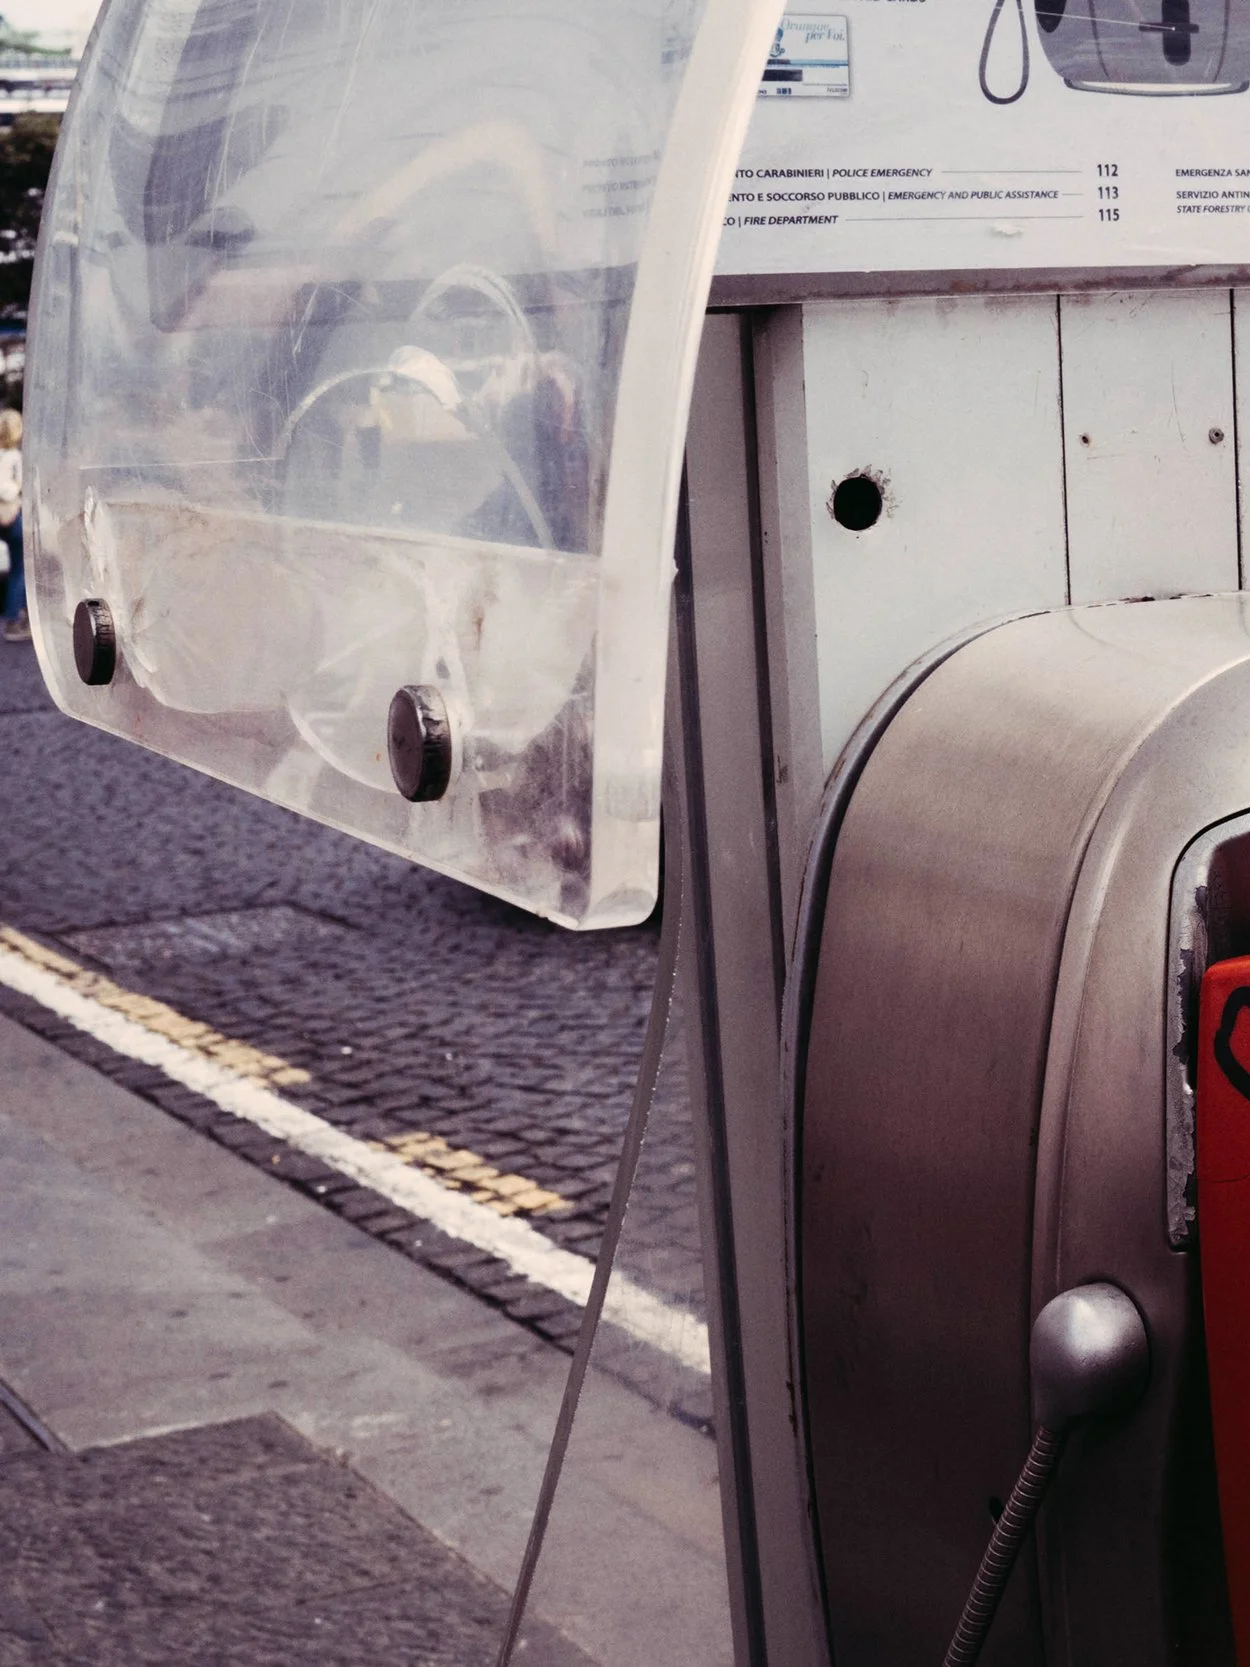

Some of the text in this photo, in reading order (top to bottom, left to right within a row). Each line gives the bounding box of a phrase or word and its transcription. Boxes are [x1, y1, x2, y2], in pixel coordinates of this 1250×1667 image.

[756, 169, 824, 178] CARABINIERI
[832, 169, 869, 178] POLICE
[870, 168, 933, 178] EMERGENCY
[1097, 164, 1119, 177] 112
[1175, 169, 1233, 177] EMERGENZA
[757, 193, 763, 201] E
[766, 192, 825, 202] SOCCORSO
[828, 192, 880, 201] PUBBLICO
[887, 191, 946, 200] EMERGENCY
[947, 191, 969, 200] AND
[970, 191, 1003, 199] PUBLIC
[1004, 190, 1059, 199] ASSISTANCE
[1098, 186, 1119, 199] 113
[1176, 191, 1219, 199] SERVIZIO
[1176, 205, 1201, 213] STATE
[1203, 205, 1245, 213] FORESTRY
[1099, 208, 1120, 221] 115
[744, 217, 767, 225] FIRE
[768, 215, 839, 225] DEPARTMENT
